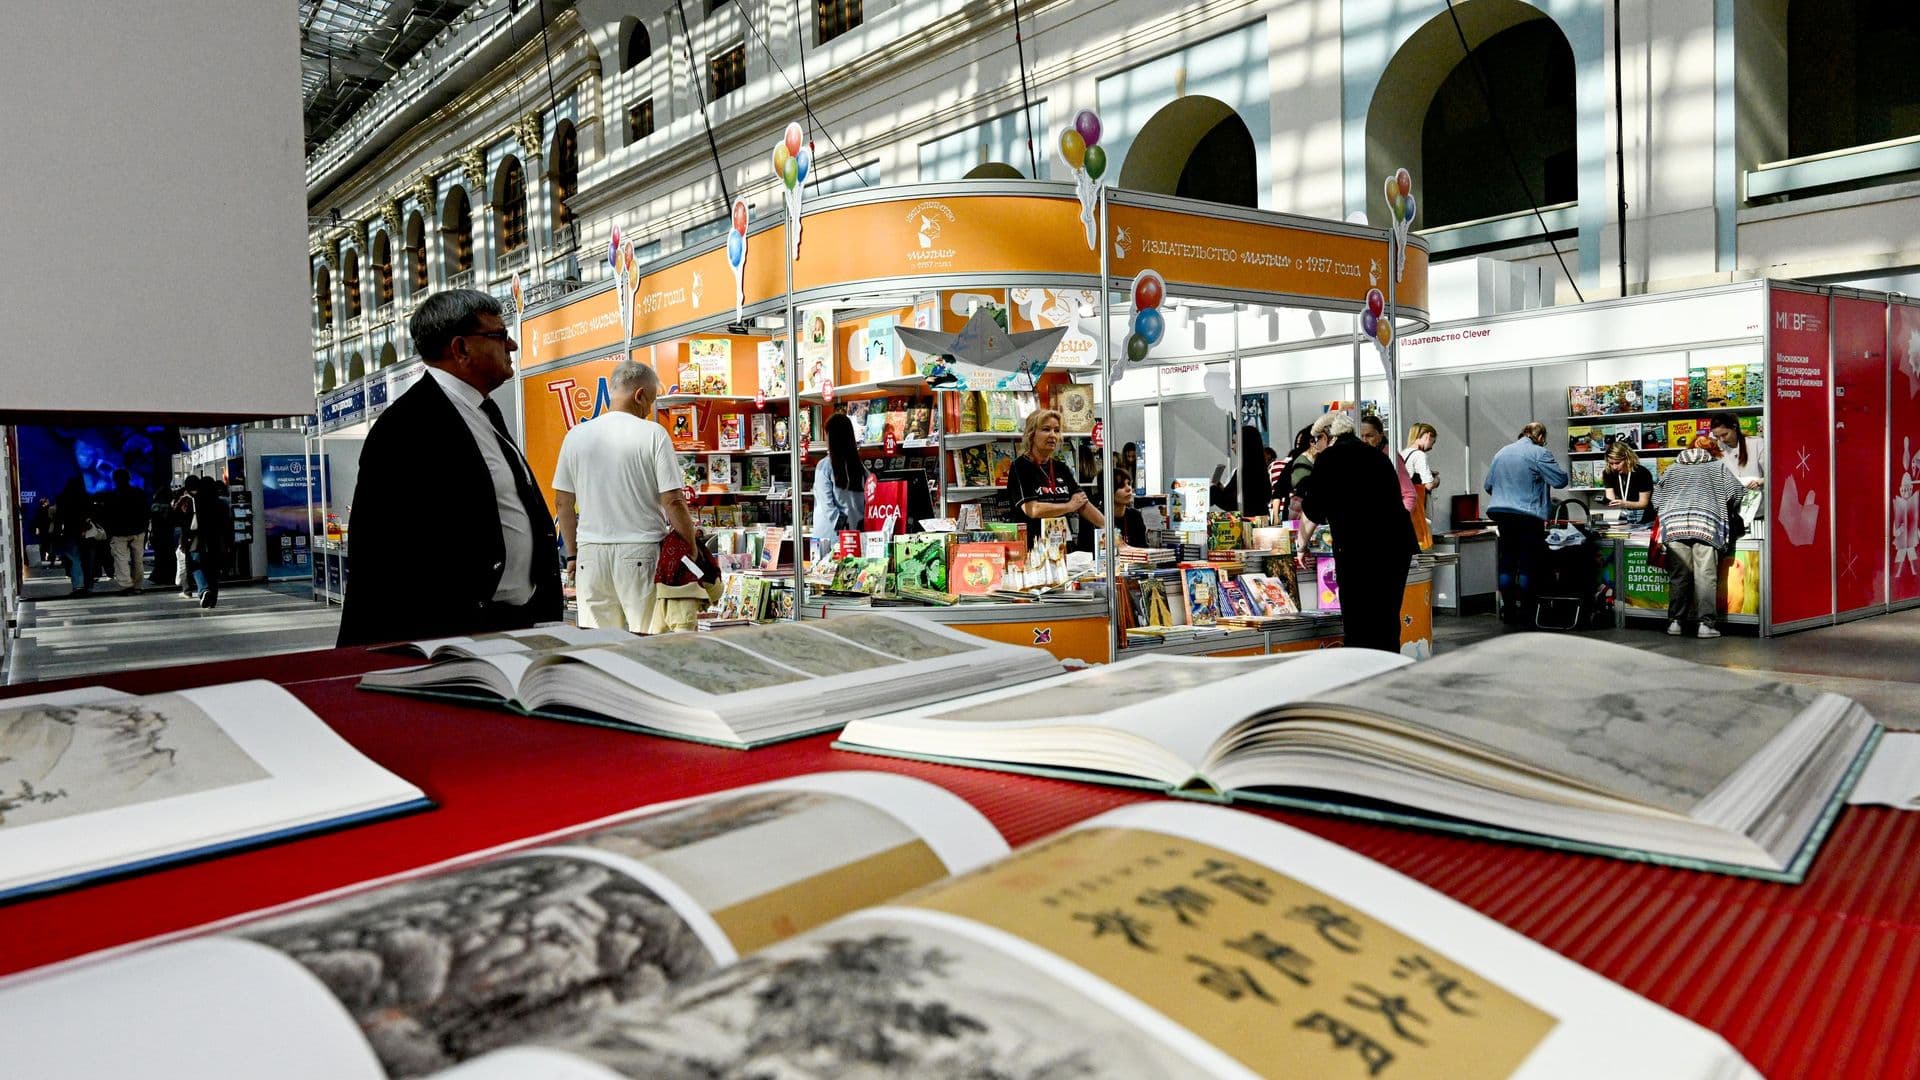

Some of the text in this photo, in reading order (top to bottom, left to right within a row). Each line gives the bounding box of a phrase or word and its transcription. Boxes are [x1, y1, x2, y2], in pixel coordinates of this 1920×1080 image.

[1142, 239, 1237, 262] ИЗДАТЕЛЬСТВО
[1306, 256, 1332, 273] 1957
[1334, 266, 1361, 277] года
[1401, 329, 1491, 346] Издательство Clever
[1160, 363, 1200, 375] ПОЛЯНДРИЯ
[867, 504, 901, 518] КАССА
[1628, 565, 1646, 574] ДЛЯ
[1628, 583, 1664, 592] И ДЕТЕЙ!
